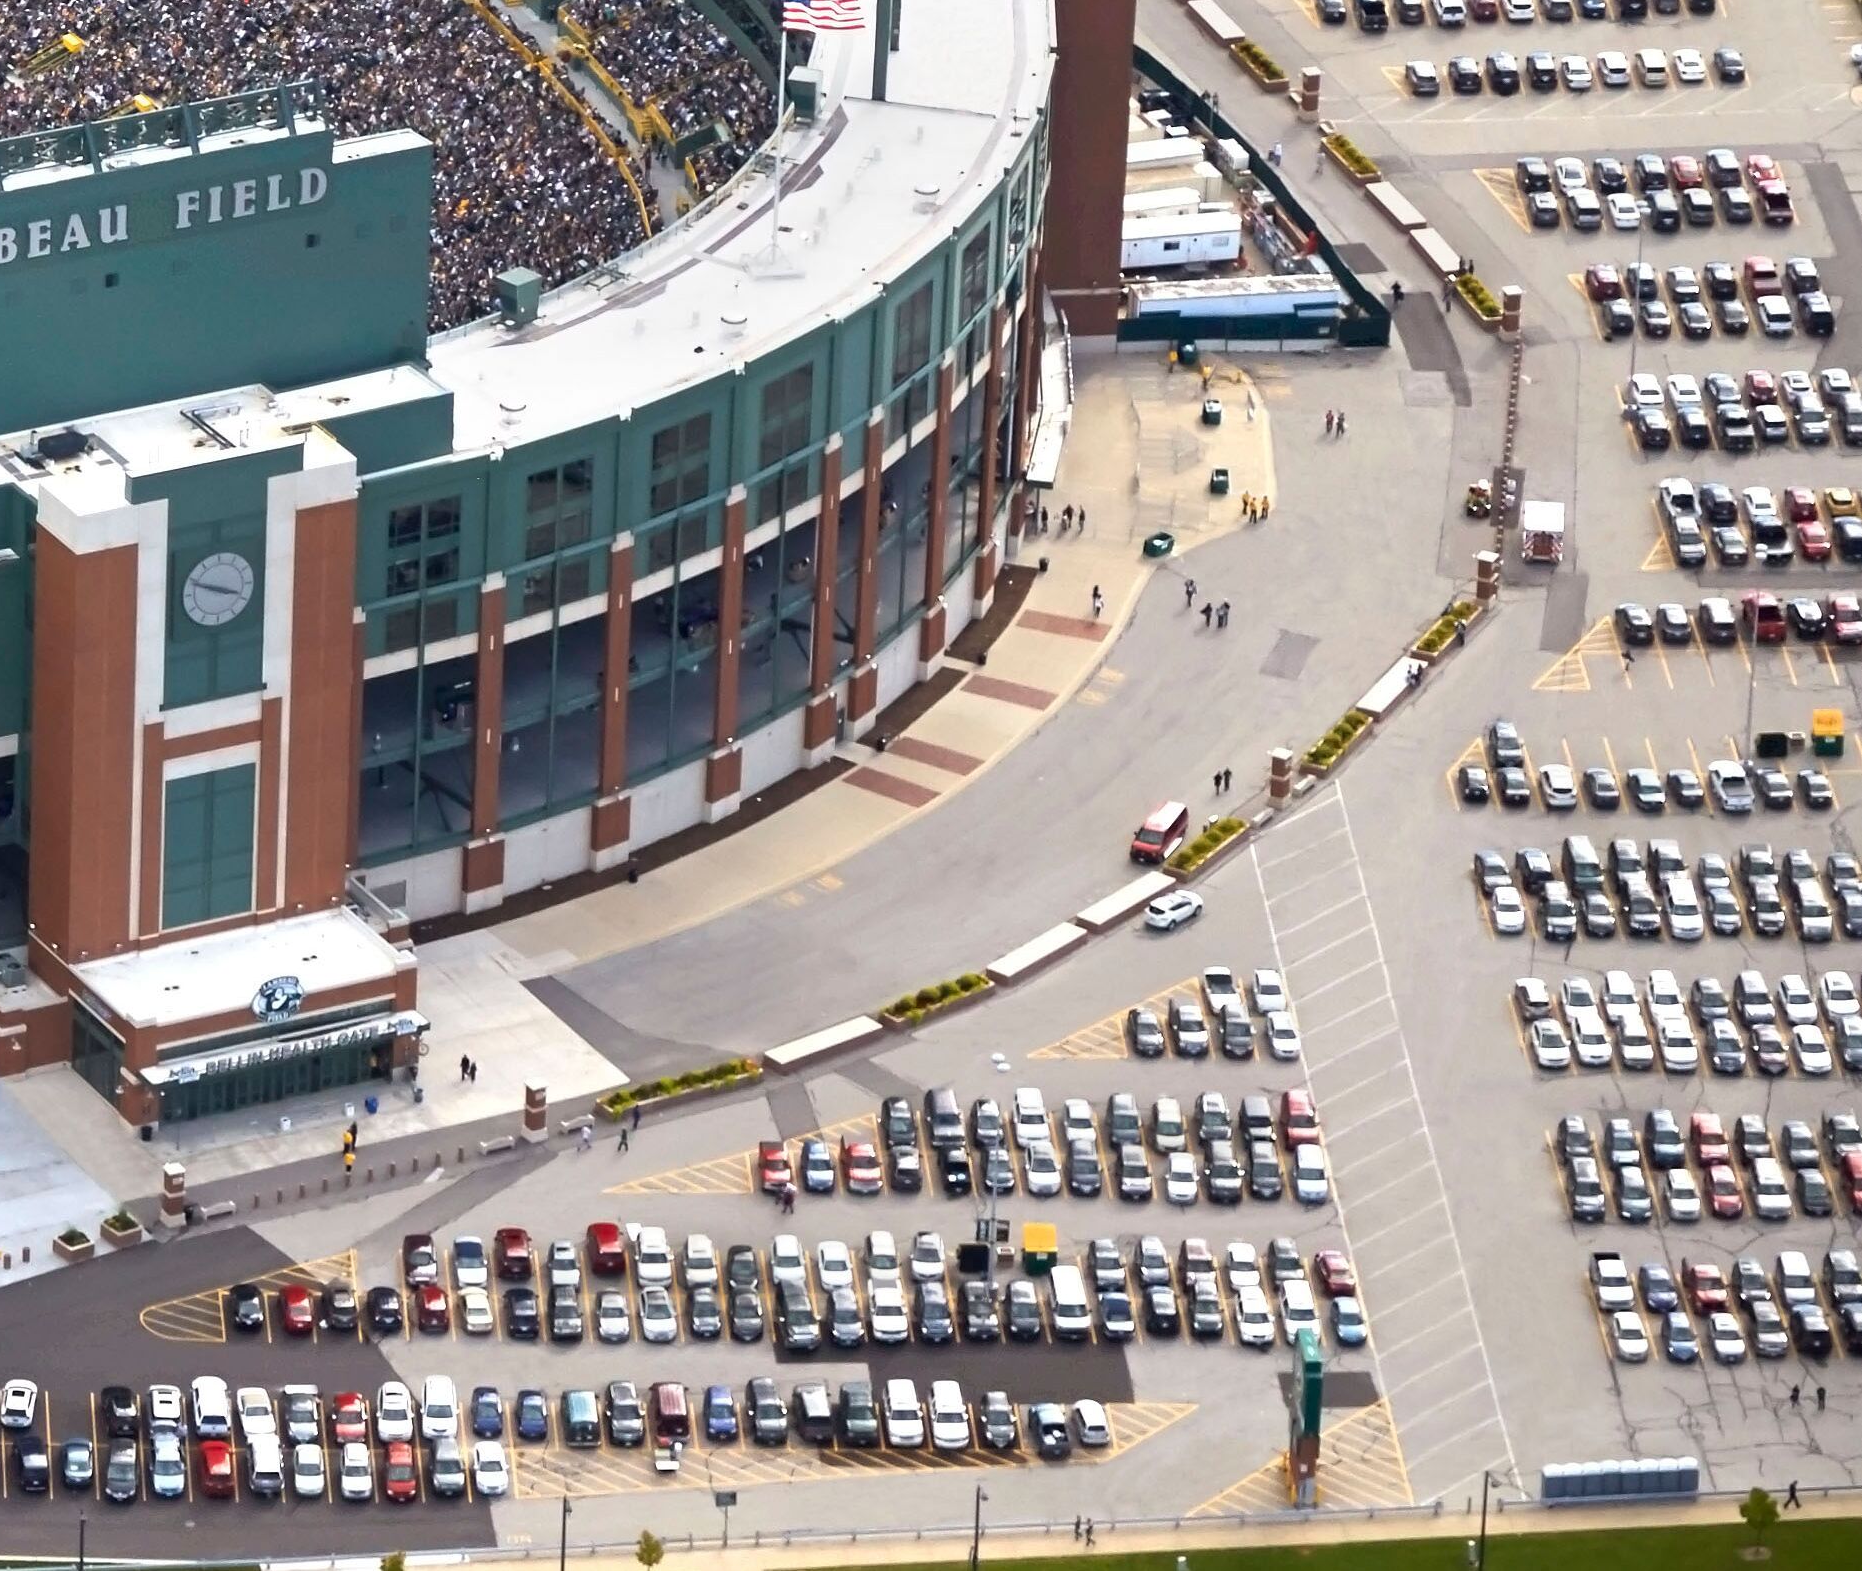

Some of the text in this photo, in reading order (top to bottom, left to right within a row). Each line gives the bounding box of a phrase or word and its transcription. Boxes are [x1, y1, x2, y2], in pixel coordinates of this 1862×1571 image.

[176, 167, 328, 229] FIELD
[206, 1025, 378, 1075] BELLIN HEALTH GATE
